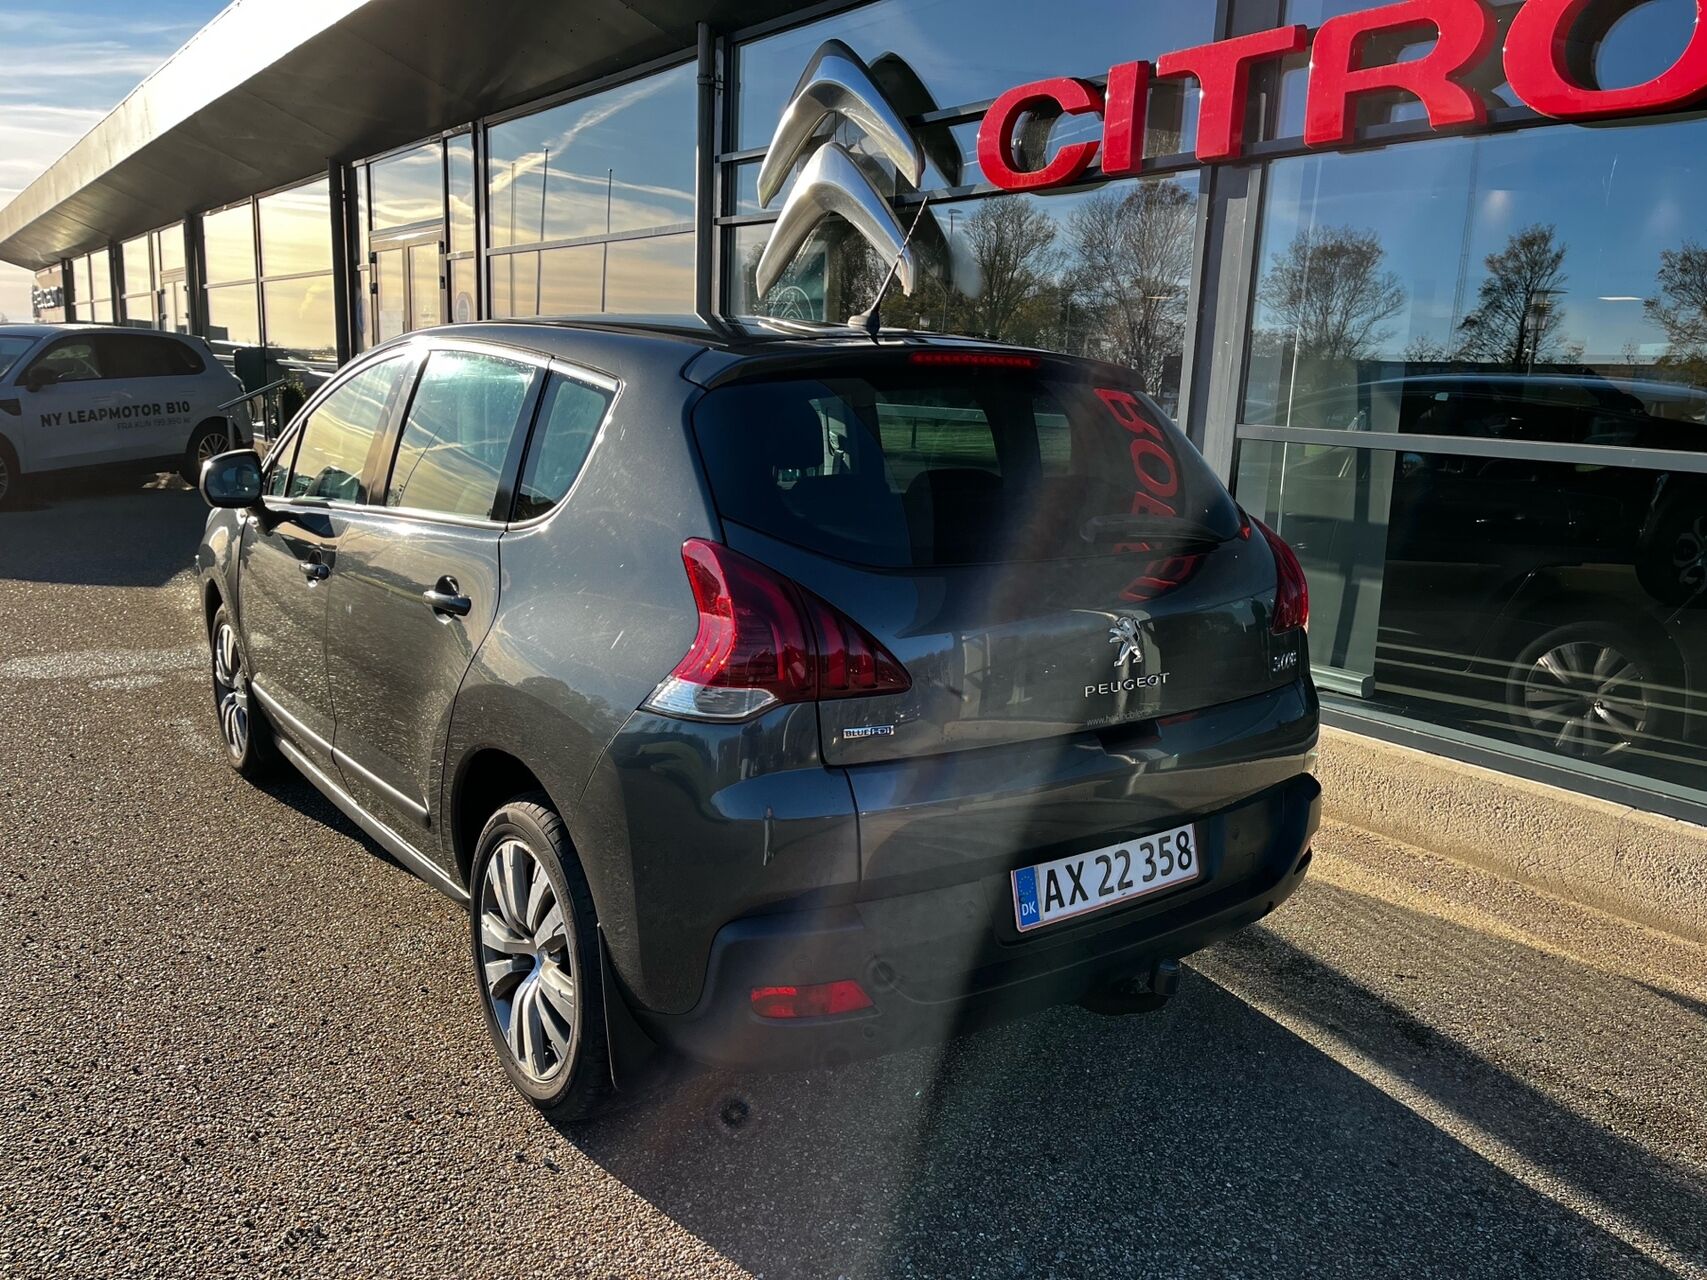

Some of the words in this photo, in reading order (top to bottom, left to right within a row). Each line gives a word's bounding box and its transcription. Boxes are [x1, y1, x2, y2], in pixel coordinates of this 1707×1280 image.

[40, 413, 62, 427] NY
[68, 403, 161, 425] LEAPMOTOR
[166, 401, 190, 414] B10
[1084, 672, 1170, 698] PEUGEOT
[1044, 860, 1089, 913] AX
[1095, 849, 1134, 897] 22
[1140, 830, 1192, 883] 358
[1021, 901, 1037, 916] DK
